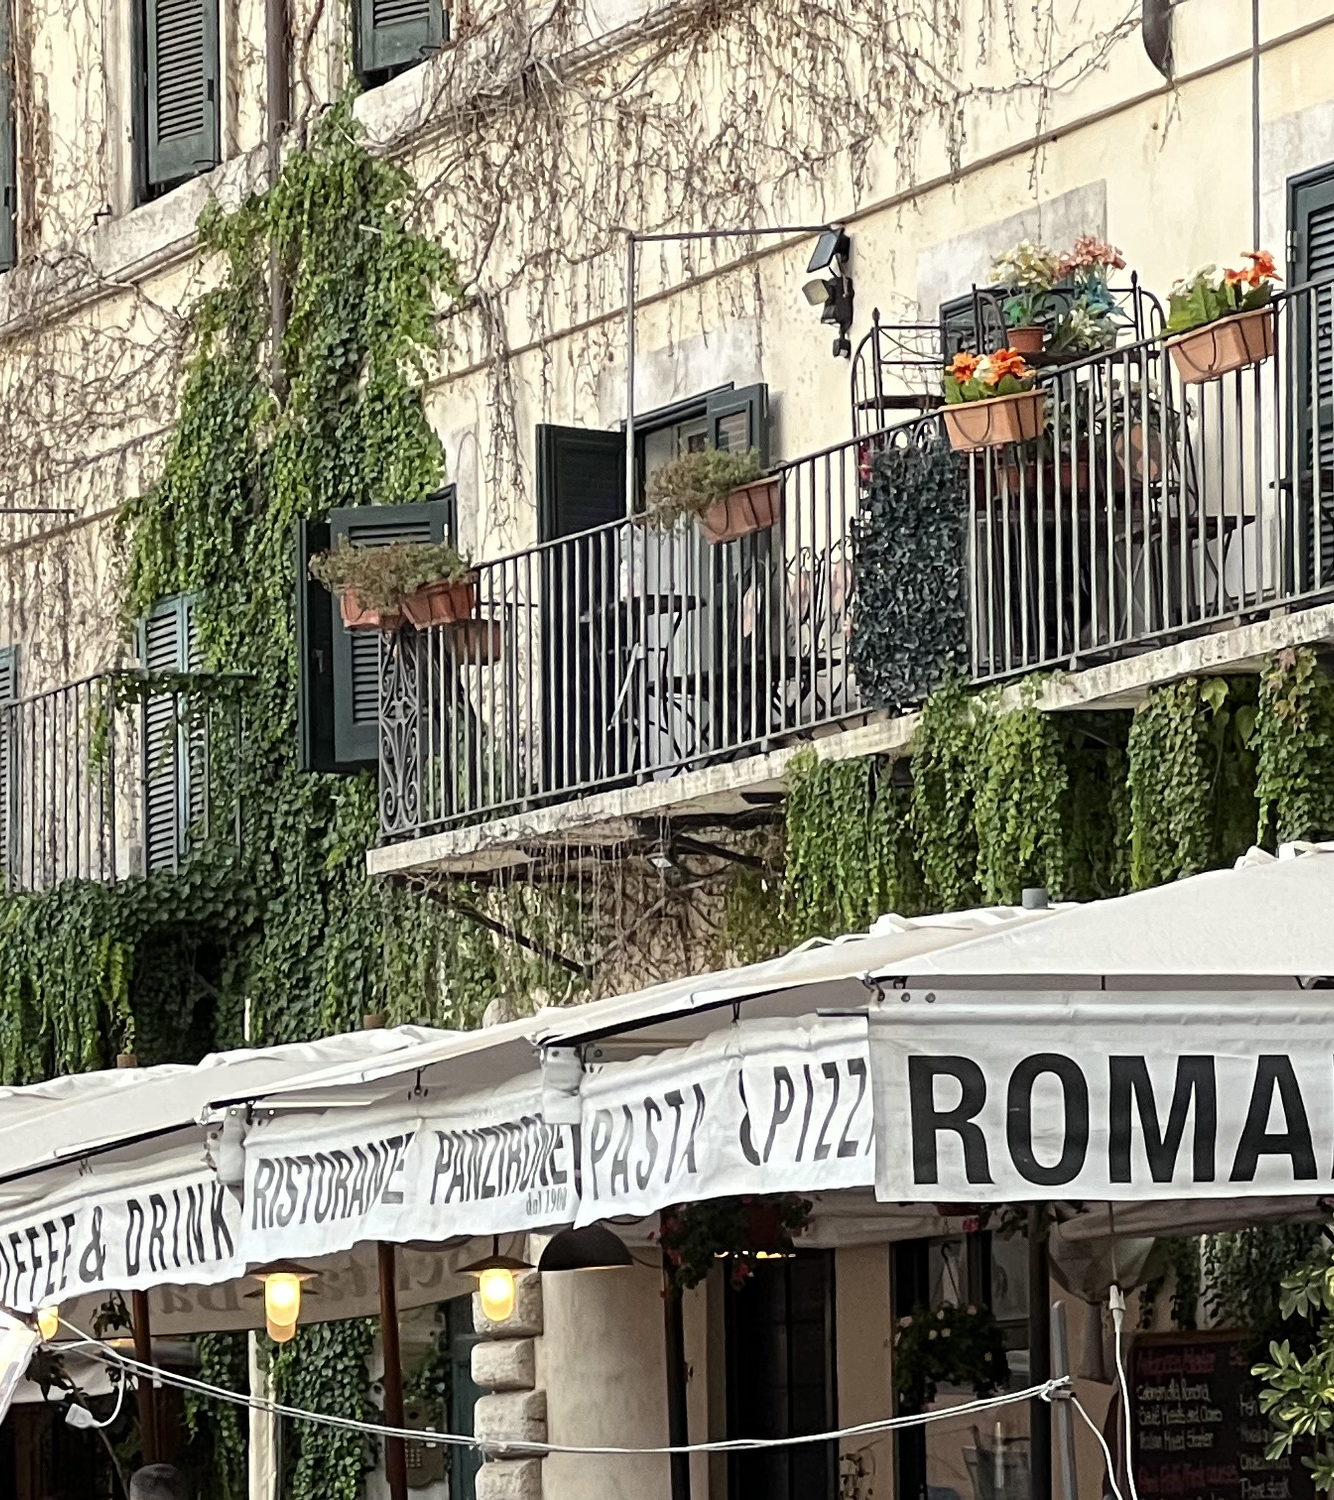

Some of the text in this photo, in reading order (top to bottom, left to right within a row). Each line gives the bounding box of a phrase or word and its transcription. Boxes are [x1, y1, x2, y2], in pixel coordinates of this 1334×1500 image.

[591, 1083, 706, 1200] PASTA
[763, 1057, 875, 1163] PIZZ
[79, 1205, 107, 1283] &
[126, 1180, 235, 1277] DRINK
